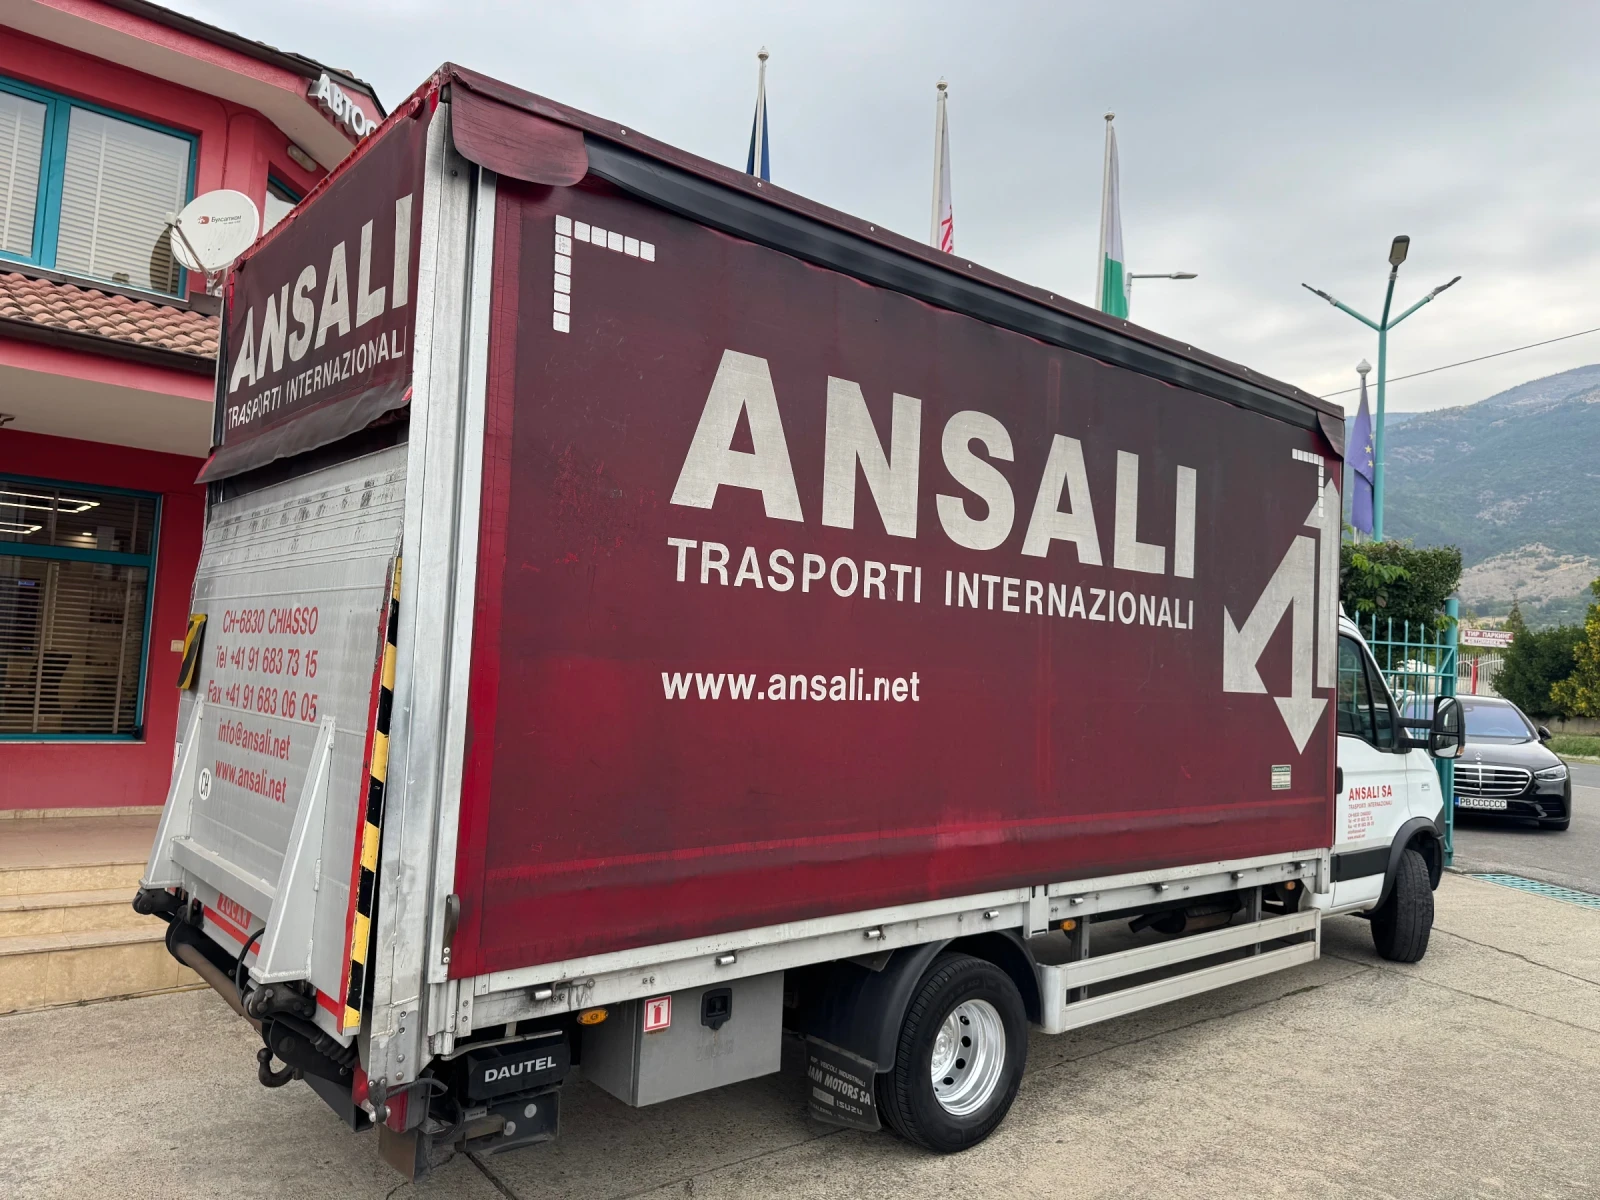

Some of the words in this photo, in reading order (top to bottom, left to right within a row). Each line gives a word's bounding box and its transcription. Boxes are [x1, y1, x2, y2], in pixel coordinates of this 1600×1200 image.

[229, 193, 412, 394] ANSALI
[669, 348, 1197, 579] ANSALI
[667, 536, 921, 603] TRASPORTI
[945, 569, 1194, 630] INTERNAZIONALI
[223, 608, 265, 634] CH-6830
[268, 606, 318, 635] CHIASSO
[230, 646, 245, 670] +41
[248, 646, 260, 671] 91
[262, 647, 283, 674] 683
[286, 648, 300, 676] 73
[305, 650, 318, 678] 15
[207, 680, 222, 704] Fax
[226, 682, 240, 707] +41
[243, 684, 255, 710] 91
[257, 686, 278, 715] 683
[281, 690, 297, 718] 06
[301, 692, 318, 722] 05
[661, 667, 920, 702] www.ansali.net
[218, 718, 291, 760] info@ansali.net
[201, 771, 210, 797] CH
[215, 759, 287, 803] www.ansali.net
[1348, 785, 1380, 801] ANSALI
[1382, 785, 1392, 797] SA
[484, 1056, 557, 1083] DAUTEL
[824, 1073, 859, 1100] MOTORS
[859, 1090, 871, 1106] SA
[836, 1099, 863, 1116] ISUZU
